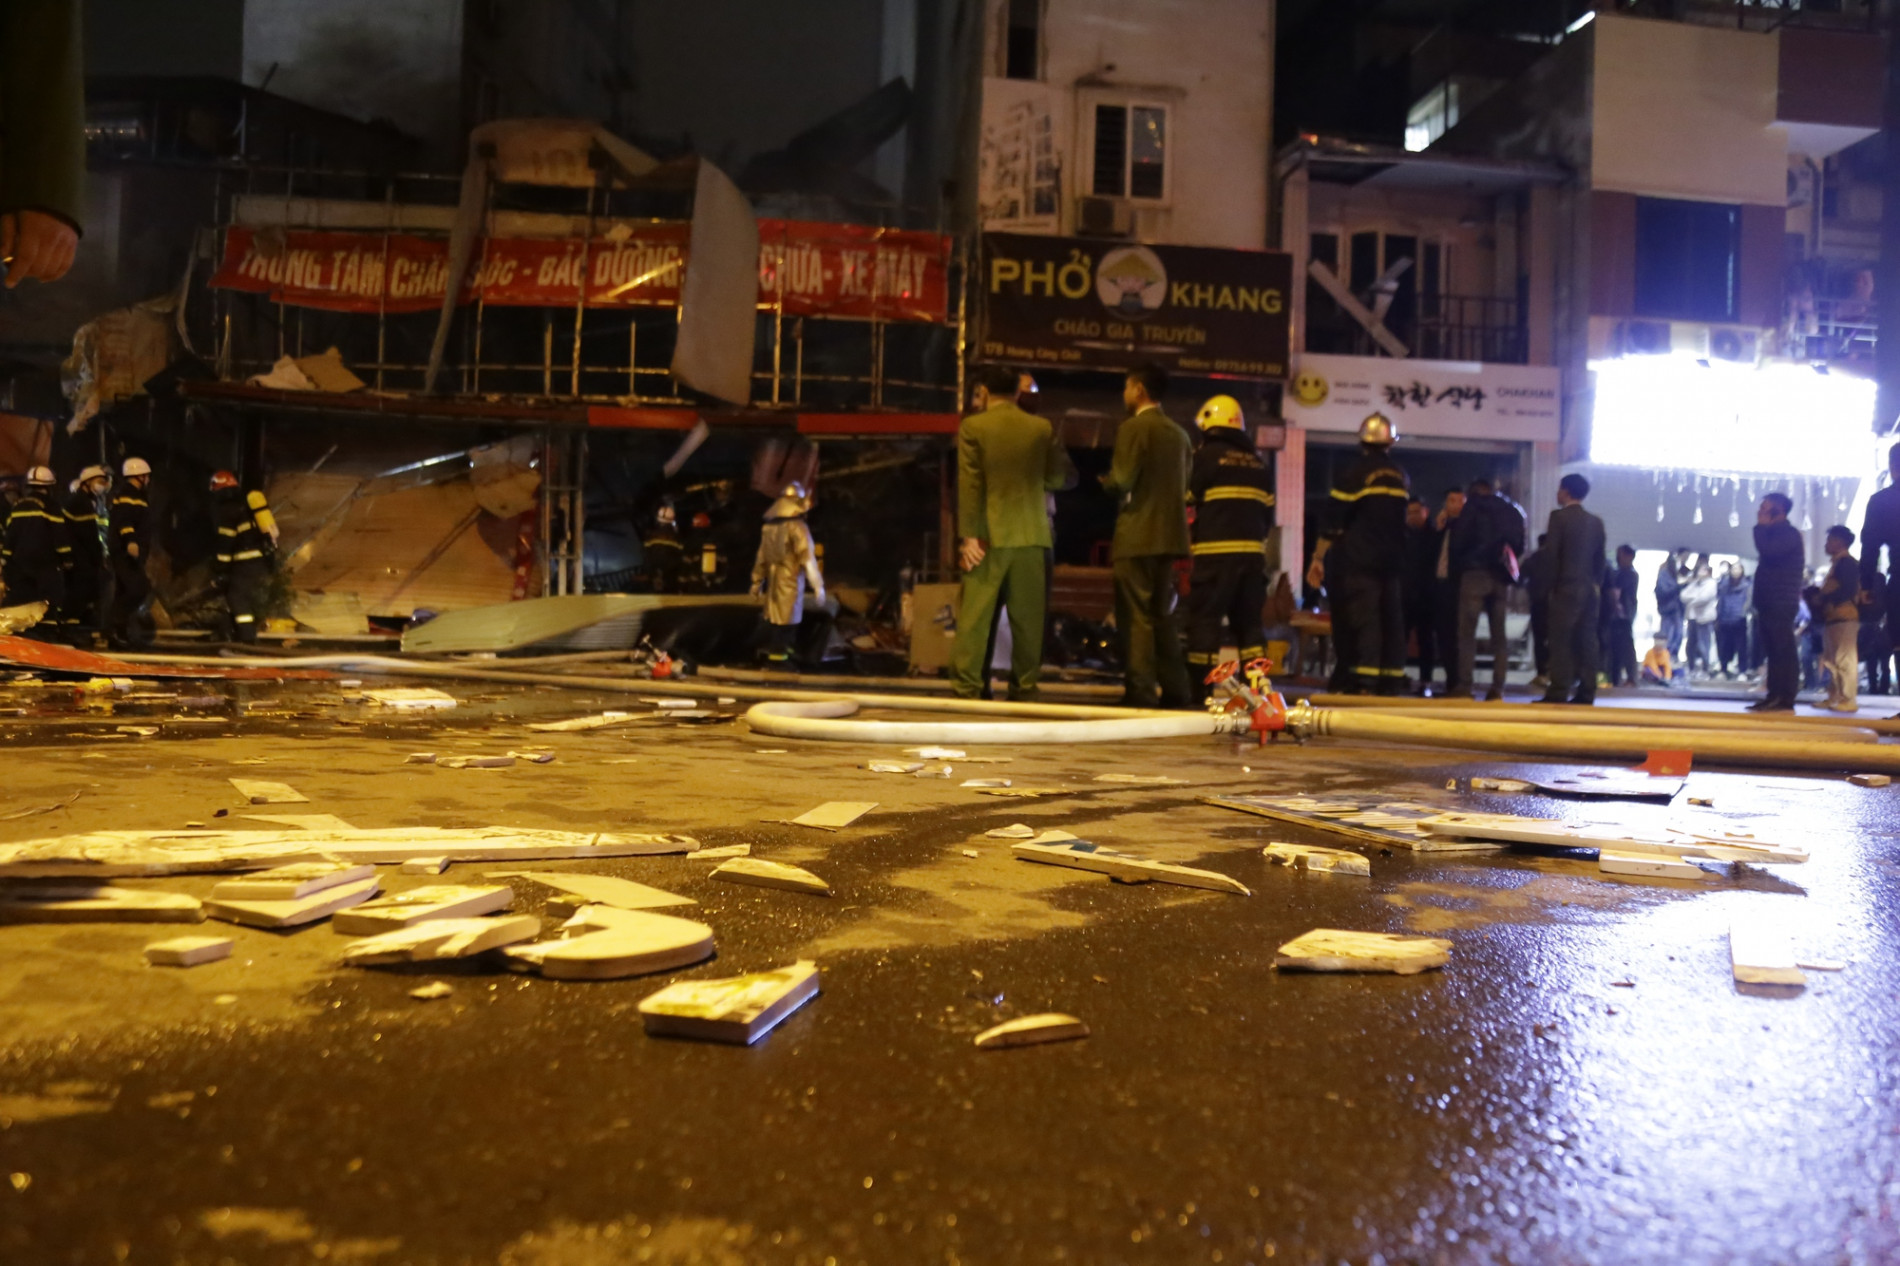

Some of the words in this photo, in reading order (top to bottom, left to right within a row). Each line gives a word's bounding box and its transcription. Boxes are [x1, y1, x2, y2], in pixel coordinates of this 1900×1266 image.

[840, 249, 869, 295] XE
[990, 248, 1092, 299] PHỞ
[1171, 280, 1283, 314] KHANG
[1106, 321, 1135, 339] GIA
